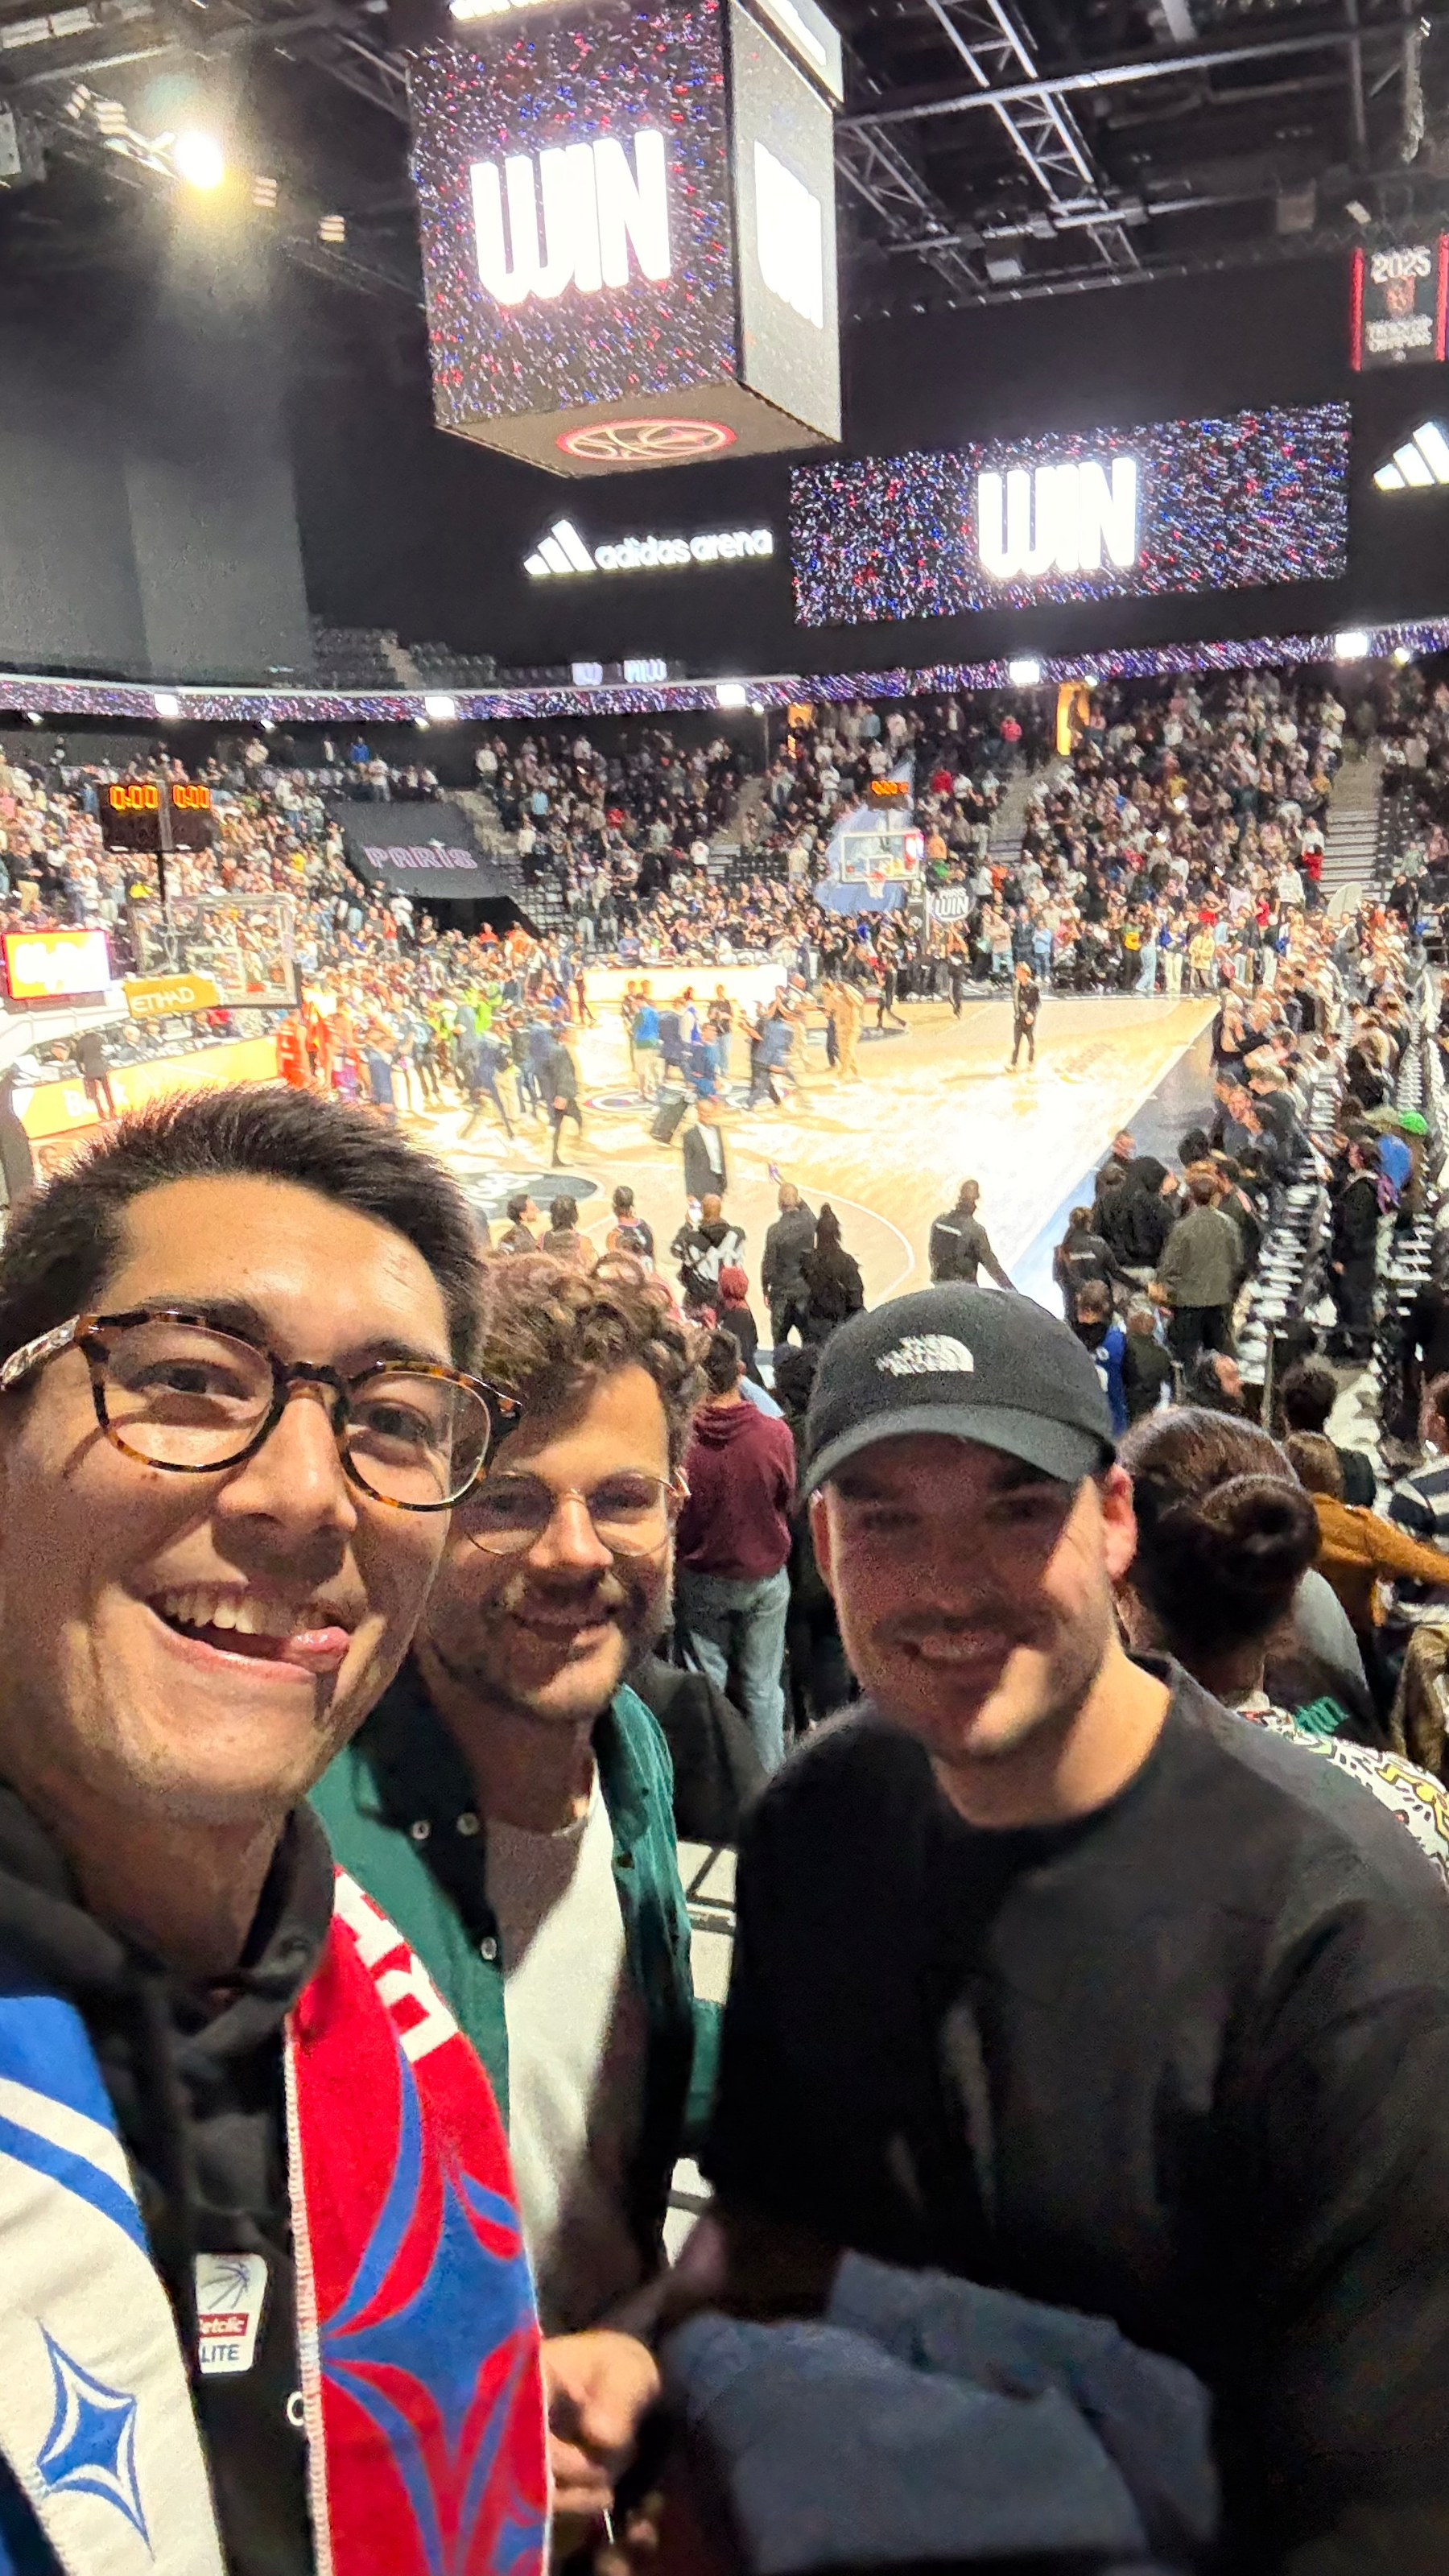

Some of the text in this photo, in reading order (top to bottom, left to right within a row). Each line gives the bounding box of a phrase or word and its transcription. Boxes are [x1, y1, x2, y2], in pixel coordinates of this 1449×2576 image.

[470, 129, 671, 305] WIN
[1370, 246, 1431, 284] 2025
[978, 456, 1137, 578] WIN
[594, 528, 773, 570] adidas arena
[364, 844, 478, 869] PARIS
[935, 895, 969, 916] WIN
[130, 986, 195, 1012] ETIHAD
